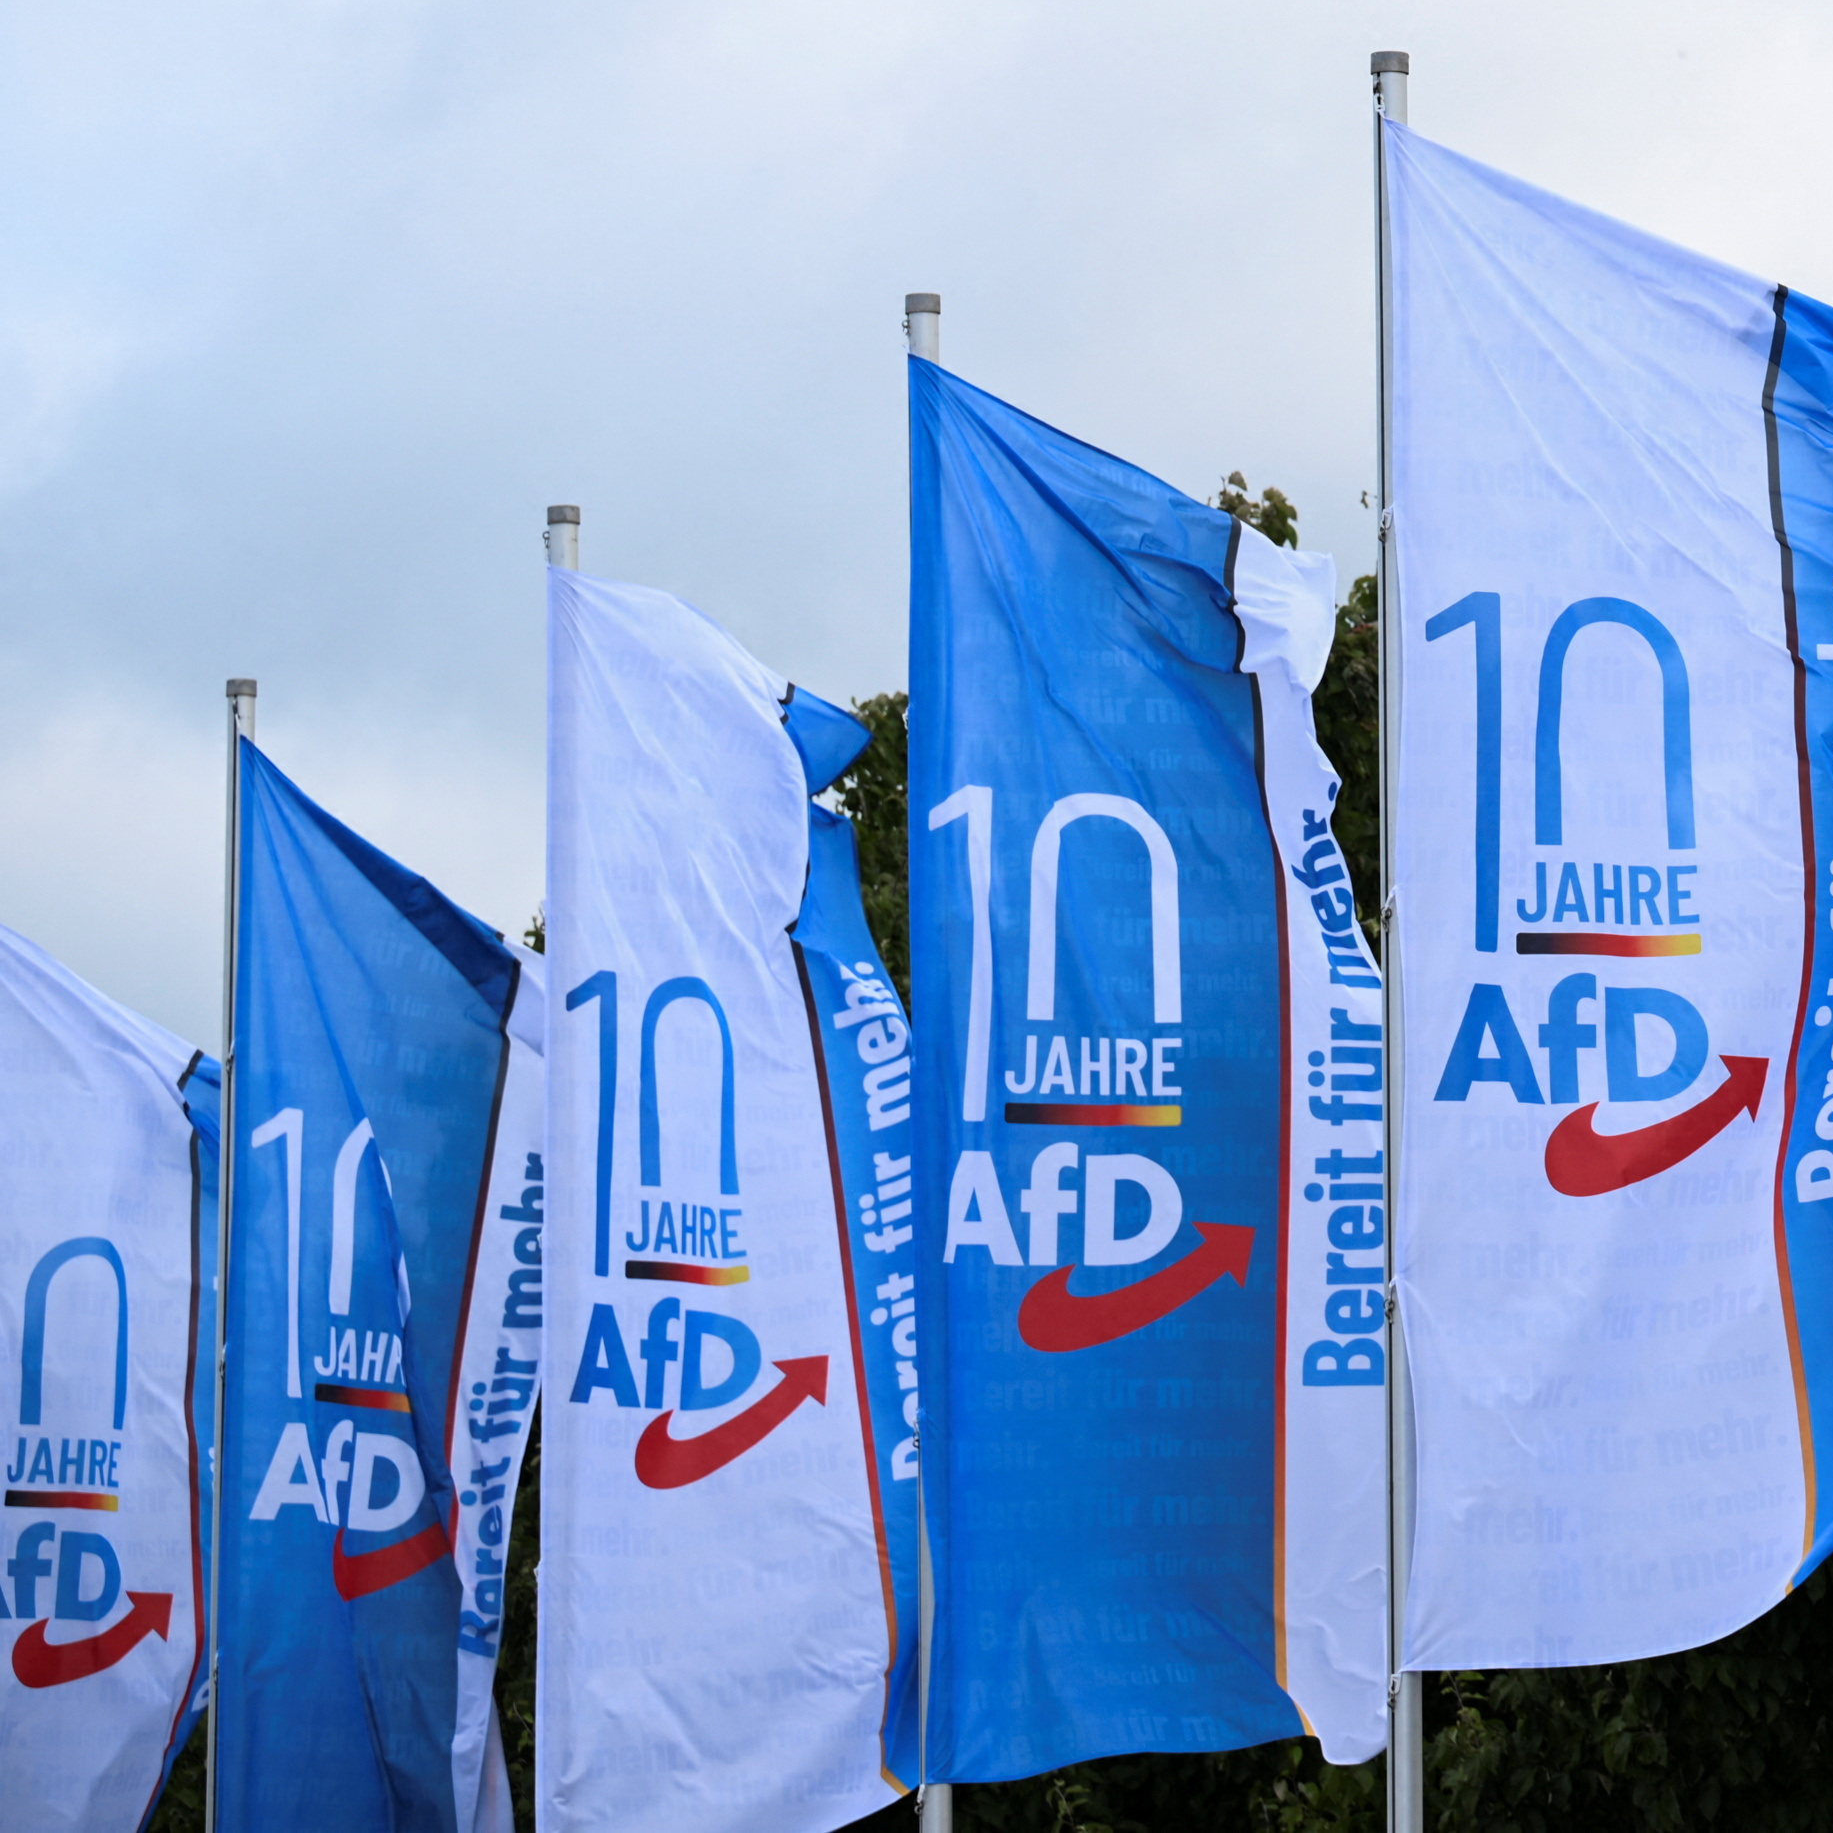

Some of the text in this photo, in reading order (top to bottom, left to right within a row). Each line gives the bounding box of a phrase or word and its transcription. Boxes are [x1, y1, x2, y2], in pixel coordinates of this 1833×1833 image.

[1516, 861, 1700, 926] JAHRE
[1004, 1035, 1182, 1097] JAHRE
[1291, 781, 1384, 1387] Bereit für mehr.
[1433, 972, 1709, 1105] AfD
[625, 1196, 746, 1261] JAHRE
[943, 1142, 1183, 1266] AfD
[569, 1296, 761, 1410] AfD
[7, 1437, 121, 1487] JAHRE
[249, 1419, 426, 1532] AfD
